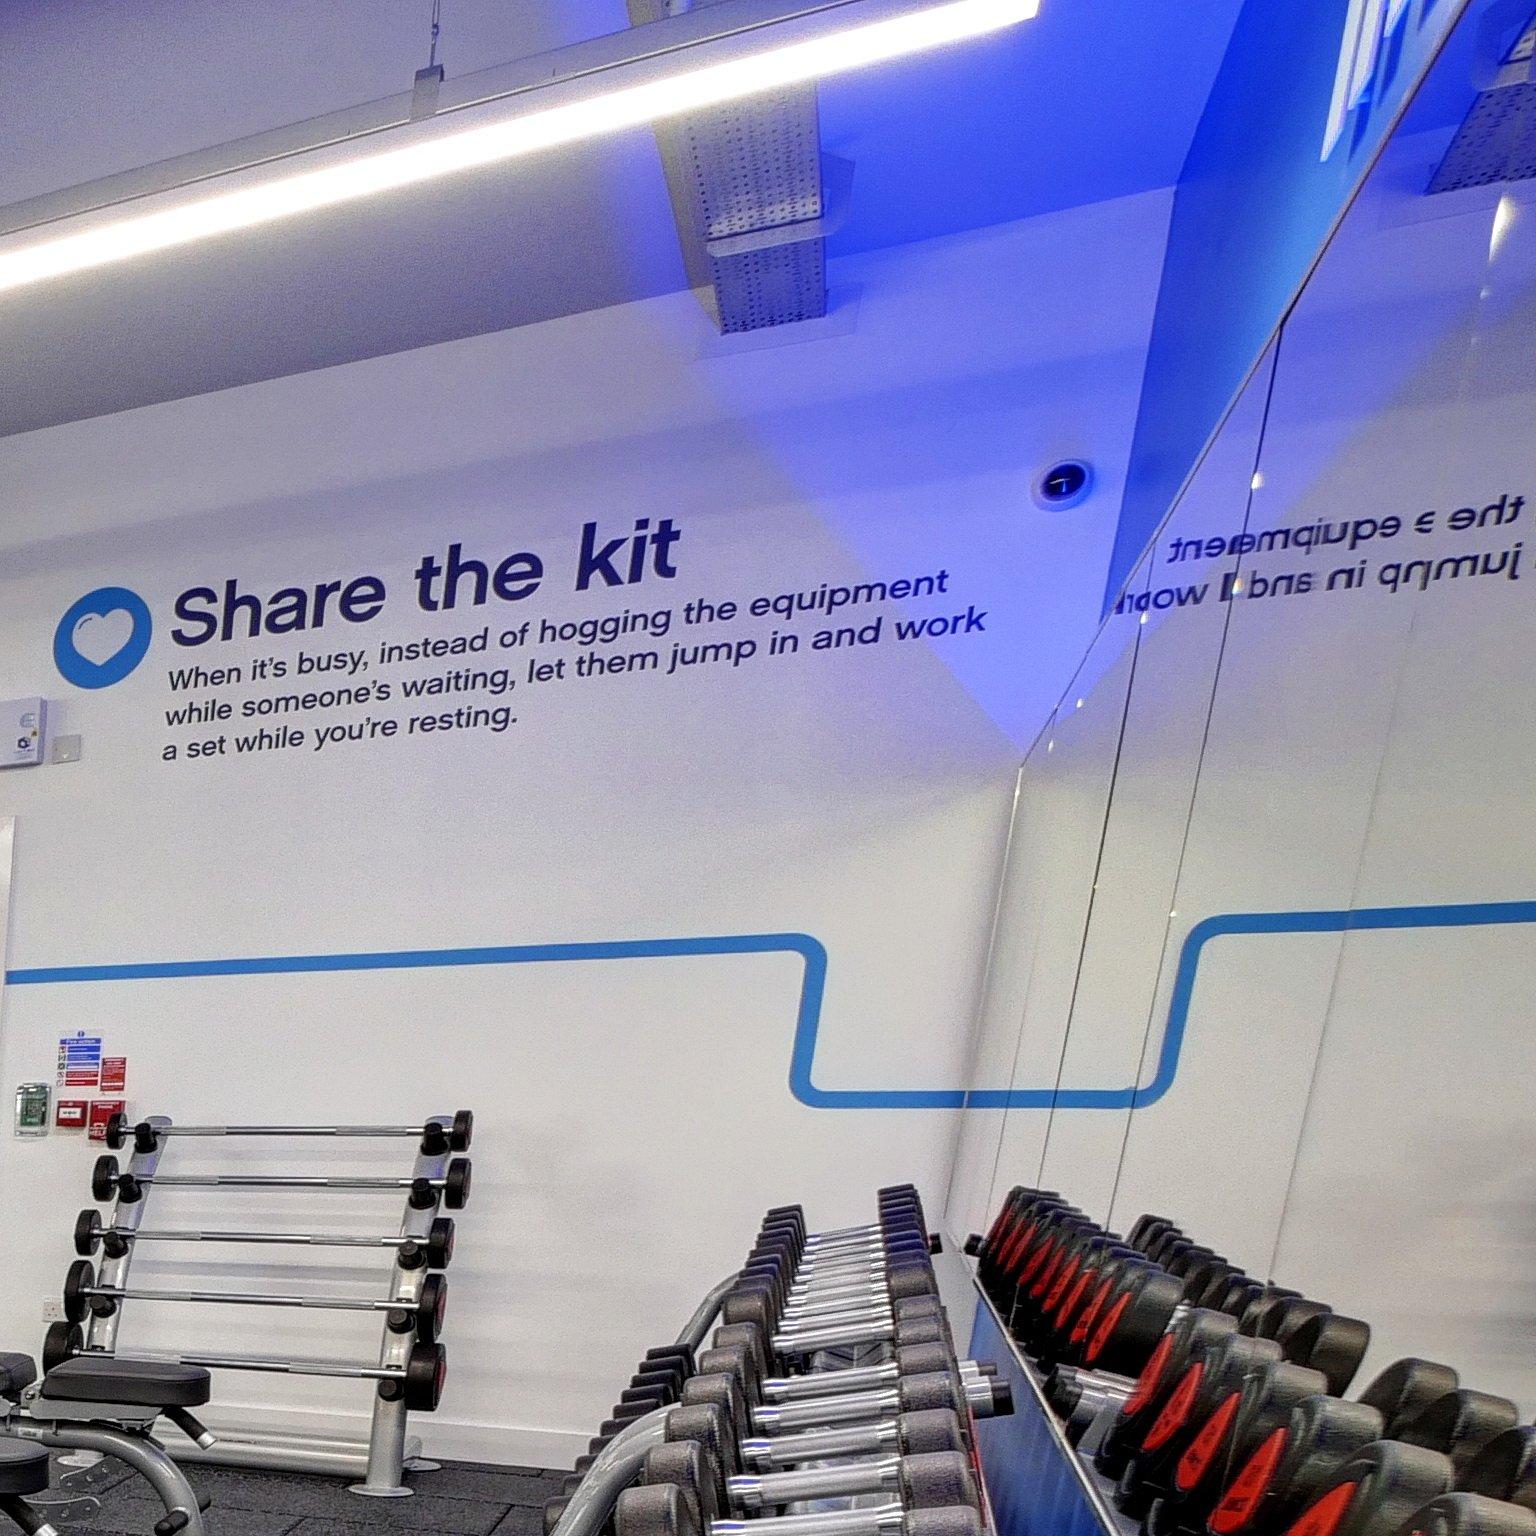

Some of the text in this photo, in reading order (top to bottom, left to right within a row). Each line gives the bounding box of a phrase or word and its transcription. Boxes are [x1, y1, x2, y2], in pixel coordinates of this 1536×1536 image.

[167, 569, 950, 692] When it's busy, instead of hogging the equipment
[170, 516, 682, 648] Share the kit
[164, 605, 989, 727] while someone's waiting, let them jump in and work
[161, 704, 518, 762] a set while you're resting.
